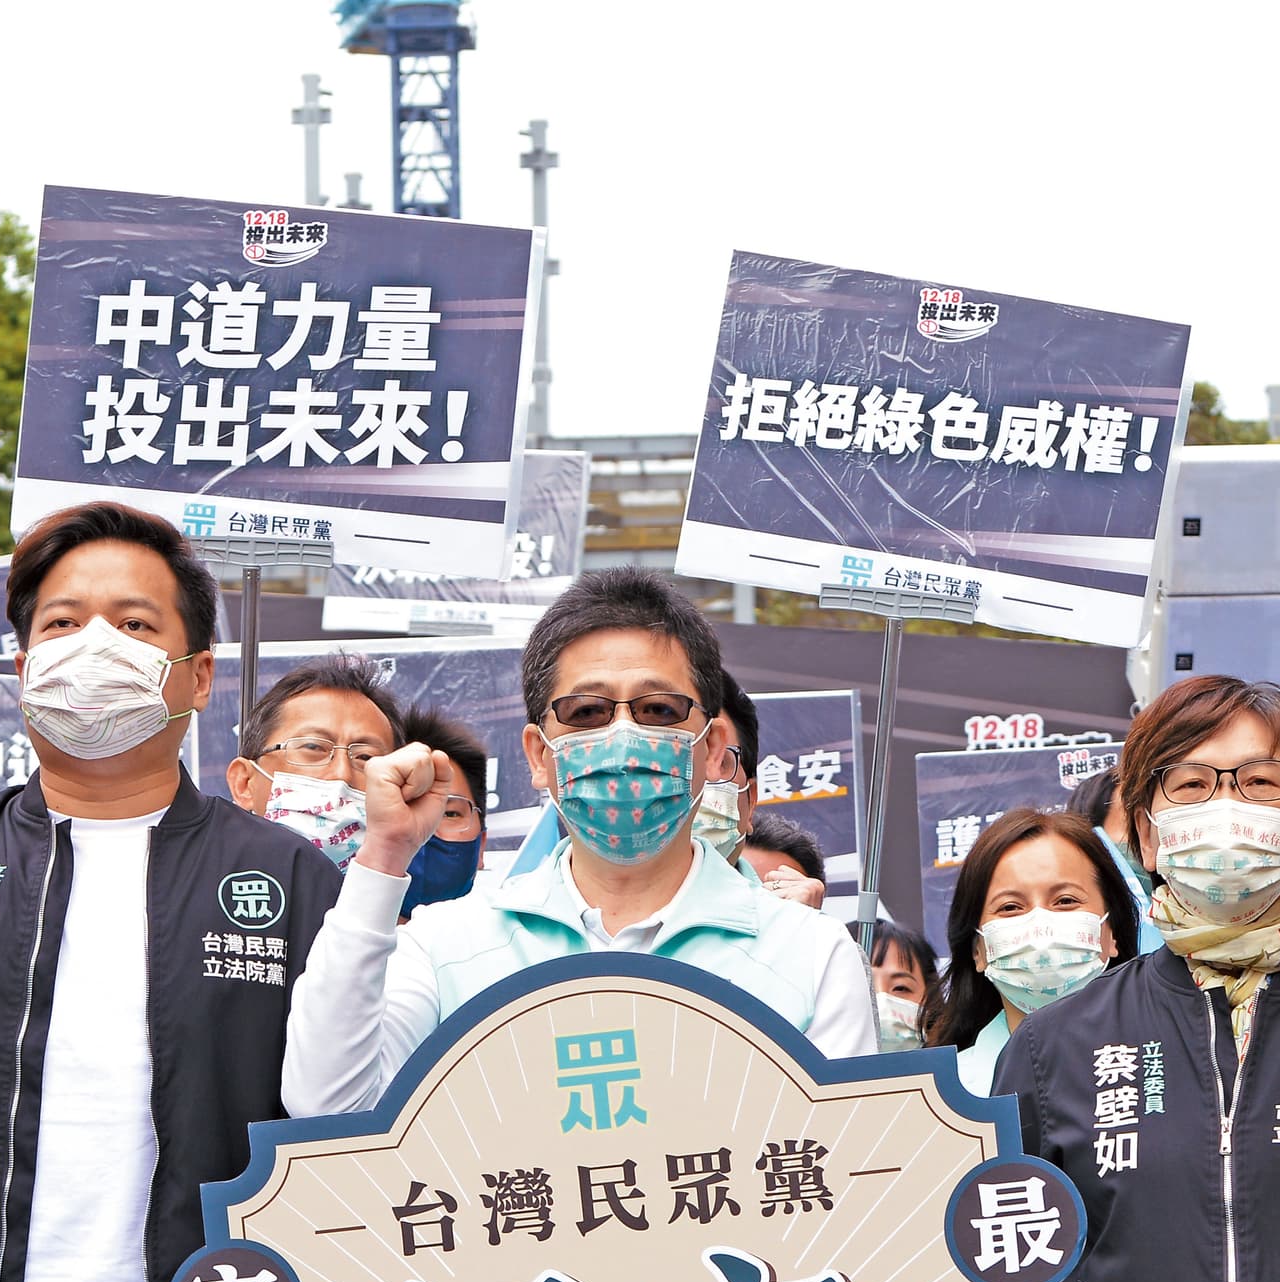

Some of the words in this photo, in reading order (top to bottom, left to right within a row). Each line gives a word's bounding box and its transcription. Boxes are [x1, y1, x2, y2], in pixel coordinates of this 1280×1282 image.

[245, 212, 288, 226] 12.18
[246, 223, 327, 246] 投出未來
[920, 302, 998, 324] 投出未來
[921, 290, 961, 304] 12.18
[95, 279, 442, 372] 中道力量
[82, 376, 469, 469] 投出未來!
[719, 372, 1162, 475] 拒絕綠色威權!
[228, 512, 333, 541] 台灣民眾黨
[969, 718, 1039, 741] 12.18
[1060, 751, 1088, 763] 12.18
[1062, 755, 1118, 777] 投出未來
[757, 749, 842, 803] 食安
[231, 880, 273, 919] 眾
[201, 931, 288, 961] 台灣民眾
[202, 956, 287, 988] 立法院黨
[553, 1029, 648, 1134] 眾
[1142, 1040, 1166, 1116] 立法委員
[1092, 1043, 1141, 1179] 蔡壁如
[392, 1137, 837, 1257] 台灣民眾黨
